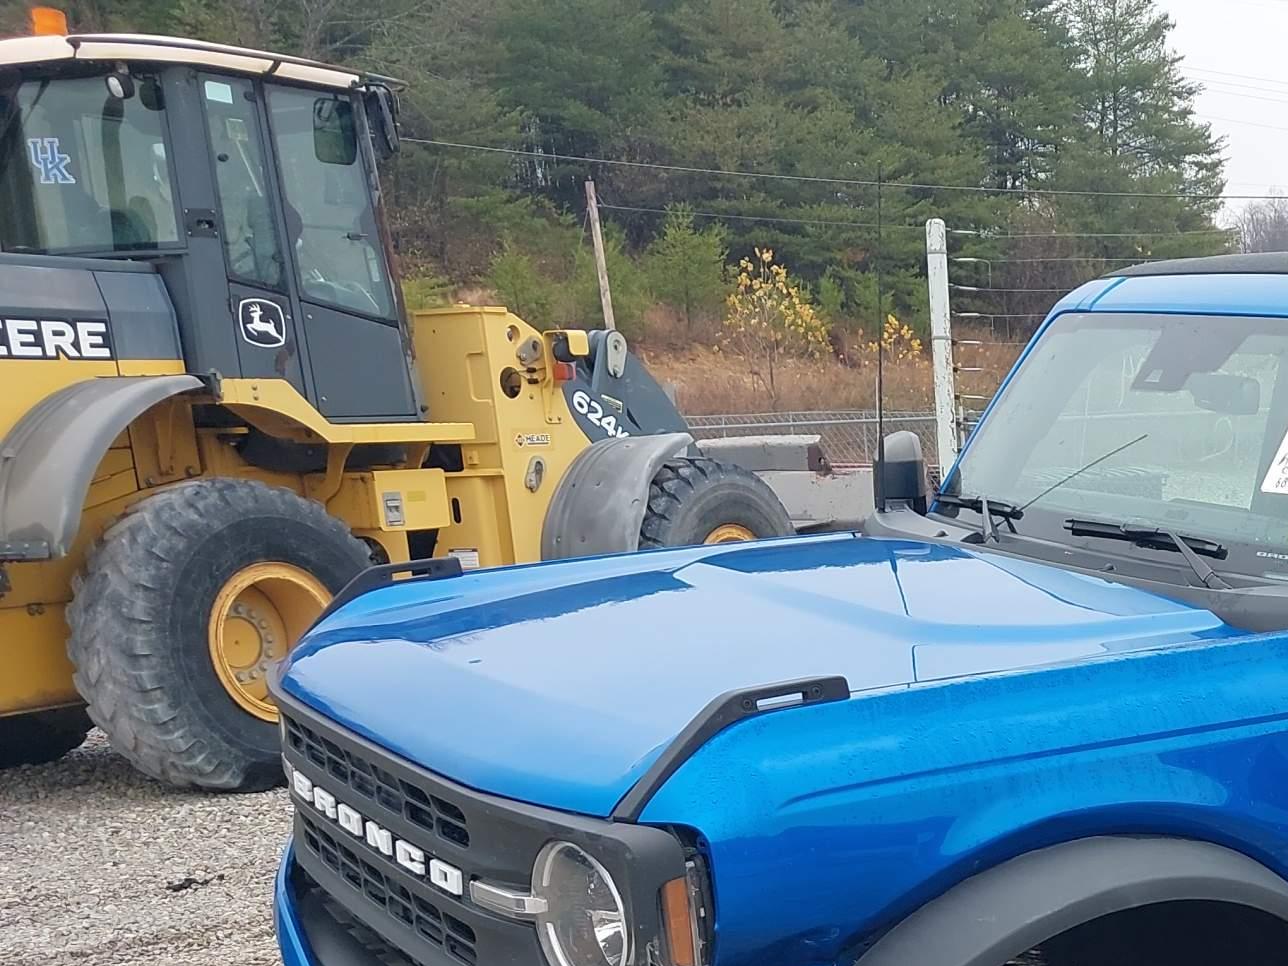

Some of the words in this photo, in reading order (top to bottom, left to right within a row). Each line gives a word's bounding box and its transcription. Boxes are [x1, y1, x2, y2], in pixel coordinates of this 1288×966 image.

[27, 138, 76, 184] UK
[0, 318, 111, 358] ERE
[293, 770, 464, 896] BRONCO
